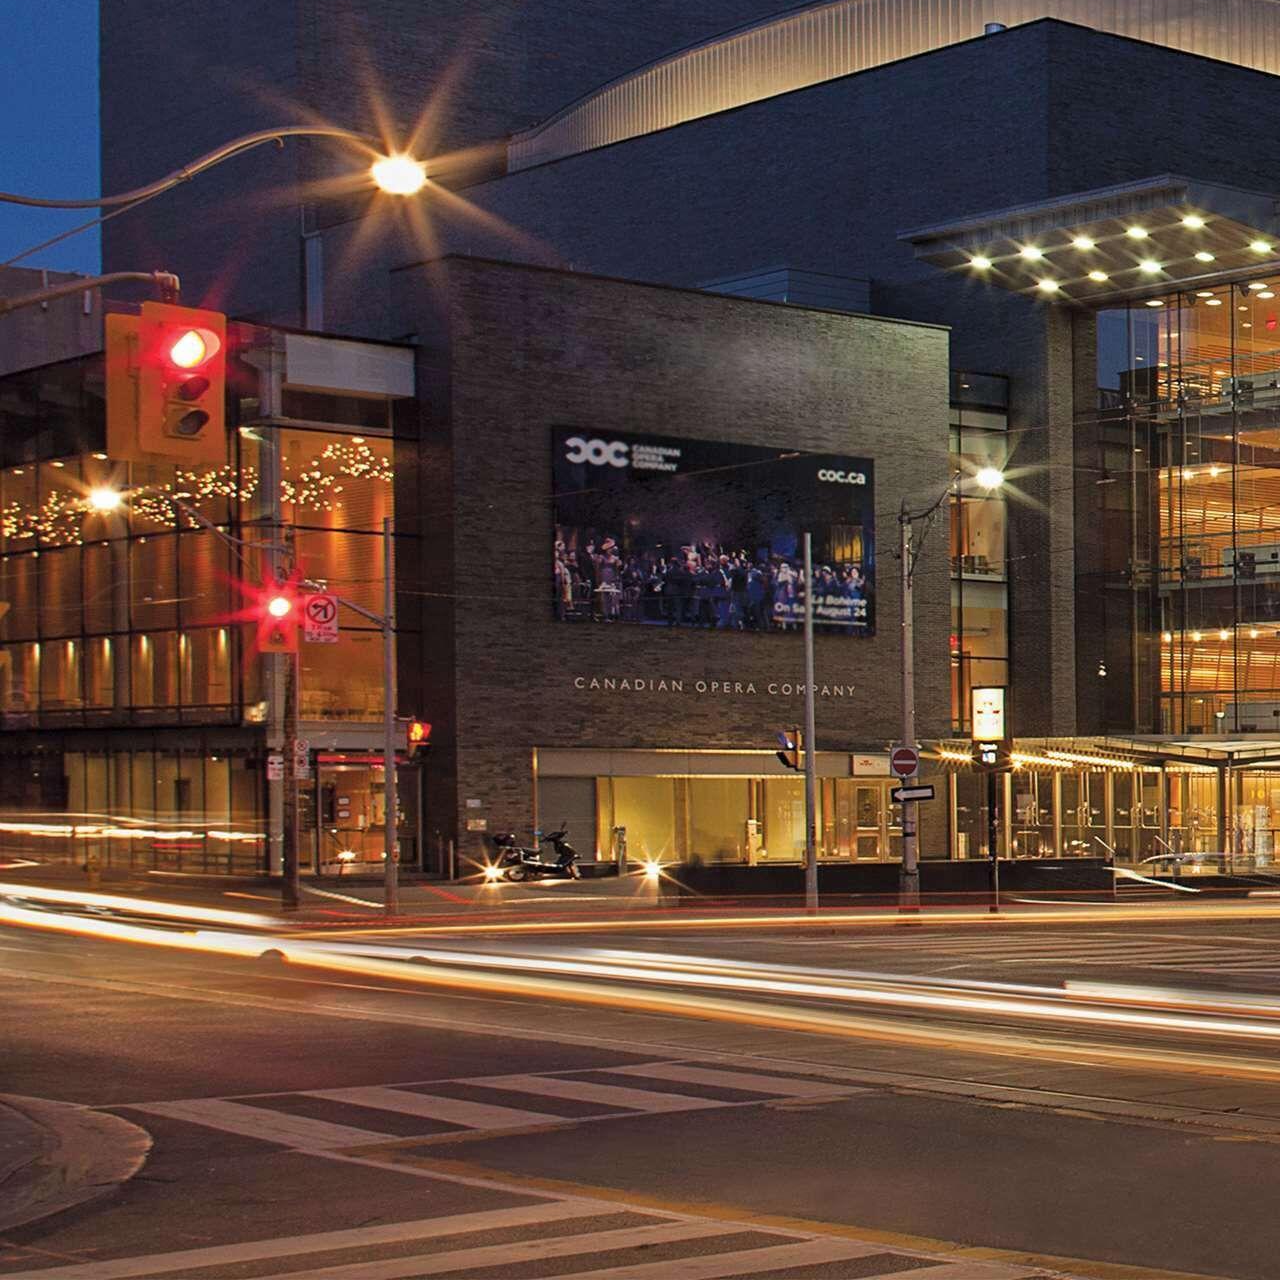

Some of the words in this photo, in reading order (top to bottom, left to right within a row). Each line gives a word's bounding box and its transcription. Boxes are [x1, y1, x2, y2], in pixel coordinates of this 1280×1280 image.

[632, 444, 681, 457] CANADIAN
[632, 460, 678, 472] COMPANY
[817, 468, 867, 485] coc.ca
[774, 601, 790, 613] On
[816, 606, 851, 618] August
[854, 606, 867, 617] 24
[574, 676, 683, 692] CANADIAN
[695, 680, 756, 695] OPERA
[767, 683, 856, 697] COMPANY
